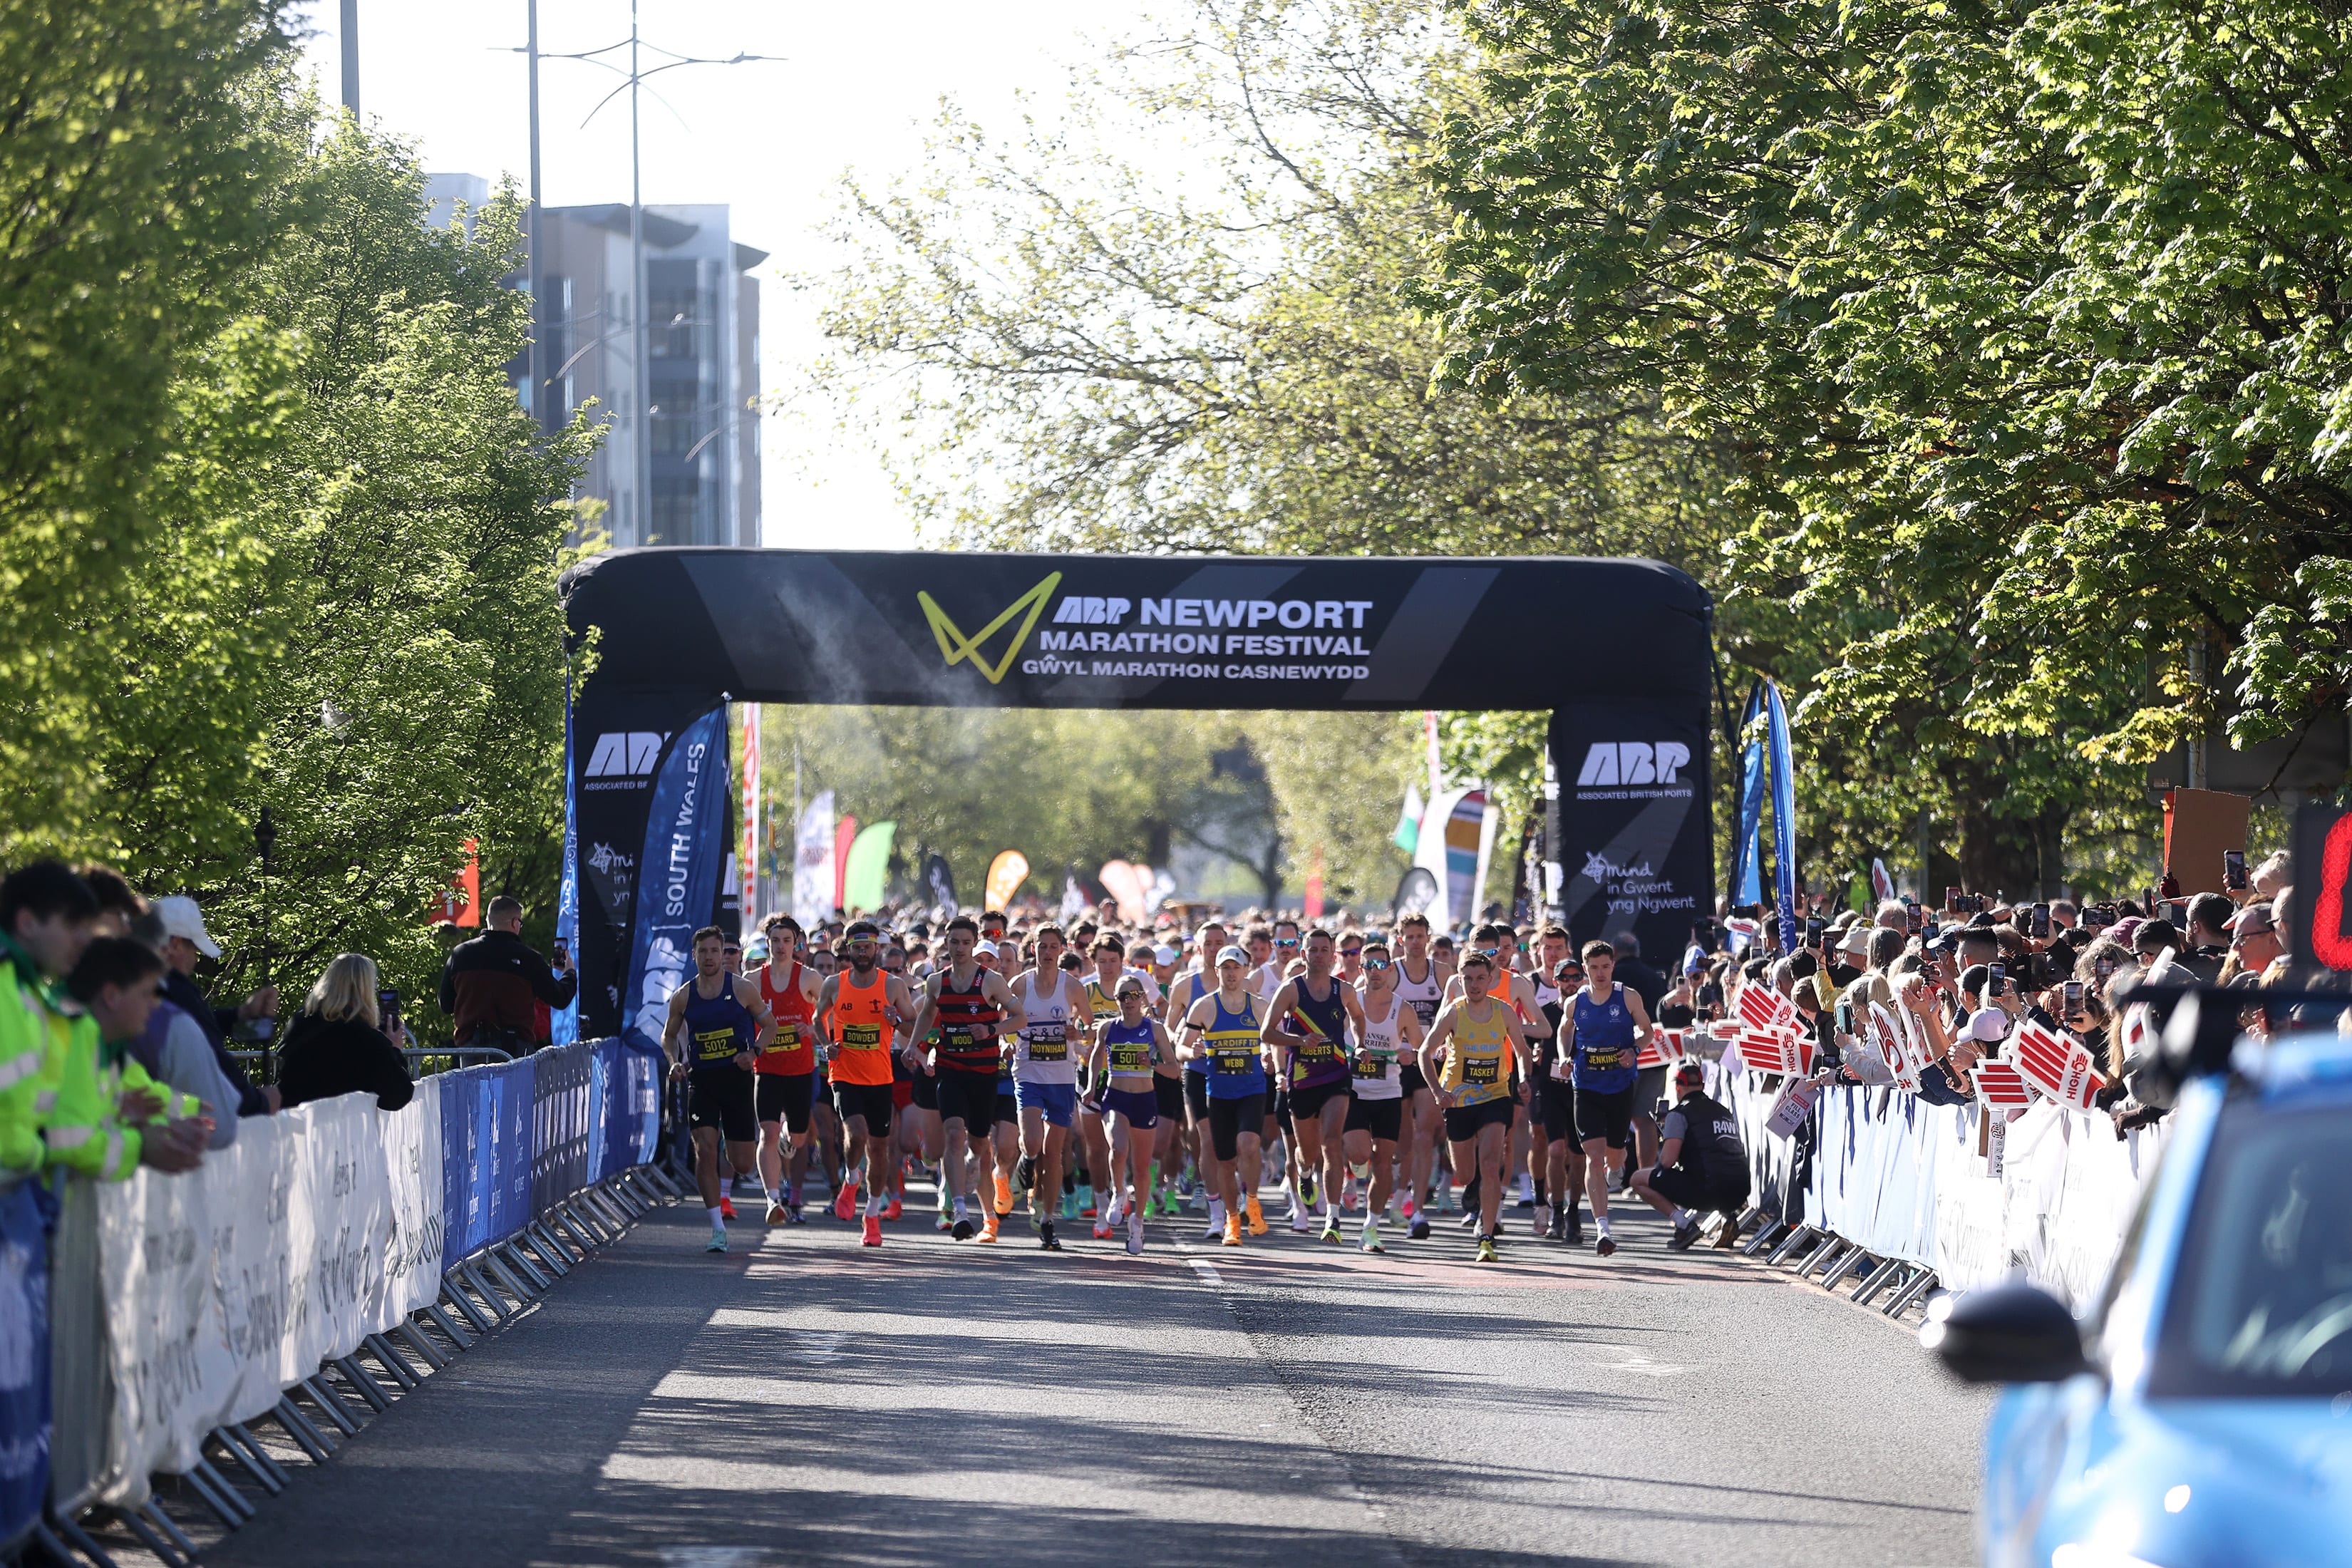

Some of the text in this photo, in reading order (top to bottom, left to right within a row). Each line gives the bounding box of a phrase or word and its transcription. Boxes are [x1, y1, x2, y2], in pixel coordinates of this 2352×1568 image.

[1052, 596, 1373, 629] ABP NEWPORT
[1040, 630, 1370, 656] MARATHON FESTIVAL
[1022, 654, 1369, 680] GŴYL MARATHON CASNEWYDD
[1577, 741, 1691, 785] ABP
[584, 781, 635, 791] ASSOCIATED
[1577, 789, 1692, 800] ASSOCIATED BRITISH PORTS
[666, 743, 706, 917] SOUTH WALES
[614, 852, 634, 867] mi
[1606, 861, 1654, 877] mind
[1607, 880, 1673, 894] in Gwent
[613, 891, 630, 907] yn
[1606, 895, 1696, 915] yng Ngwent
[847, 1032, 876, 1042] BOWDEN
[1041, 1027, 1048, 1037] &
[1053, 1026, 1060, 1036] C
[951, 1036, 973, 1045] WOOD
[1366, 1033, 1391, 1042] ANSEA
[704, 1038, 728, 1053] 5012
[1031, 1043, 1066, 1053] MOYNIHAN
[1212, 1039, 1247, 1048] CARDIFF
[1364, 1039, 1391, 1048] RRIERS
[1299, 1044, 1331, 1056] ROBERTS
[1120, 1053, 1139, 1063] 501
[1224, 1058, 1244, 1068] WEBB
[1589, 1054, 1618, 1064] JENKINS
[1358, 1063, 1377, 1073] REES
[1470, 1067, 1495, 1077] TASKER
[2067, 1053, 2088, 1100] HIGH5
